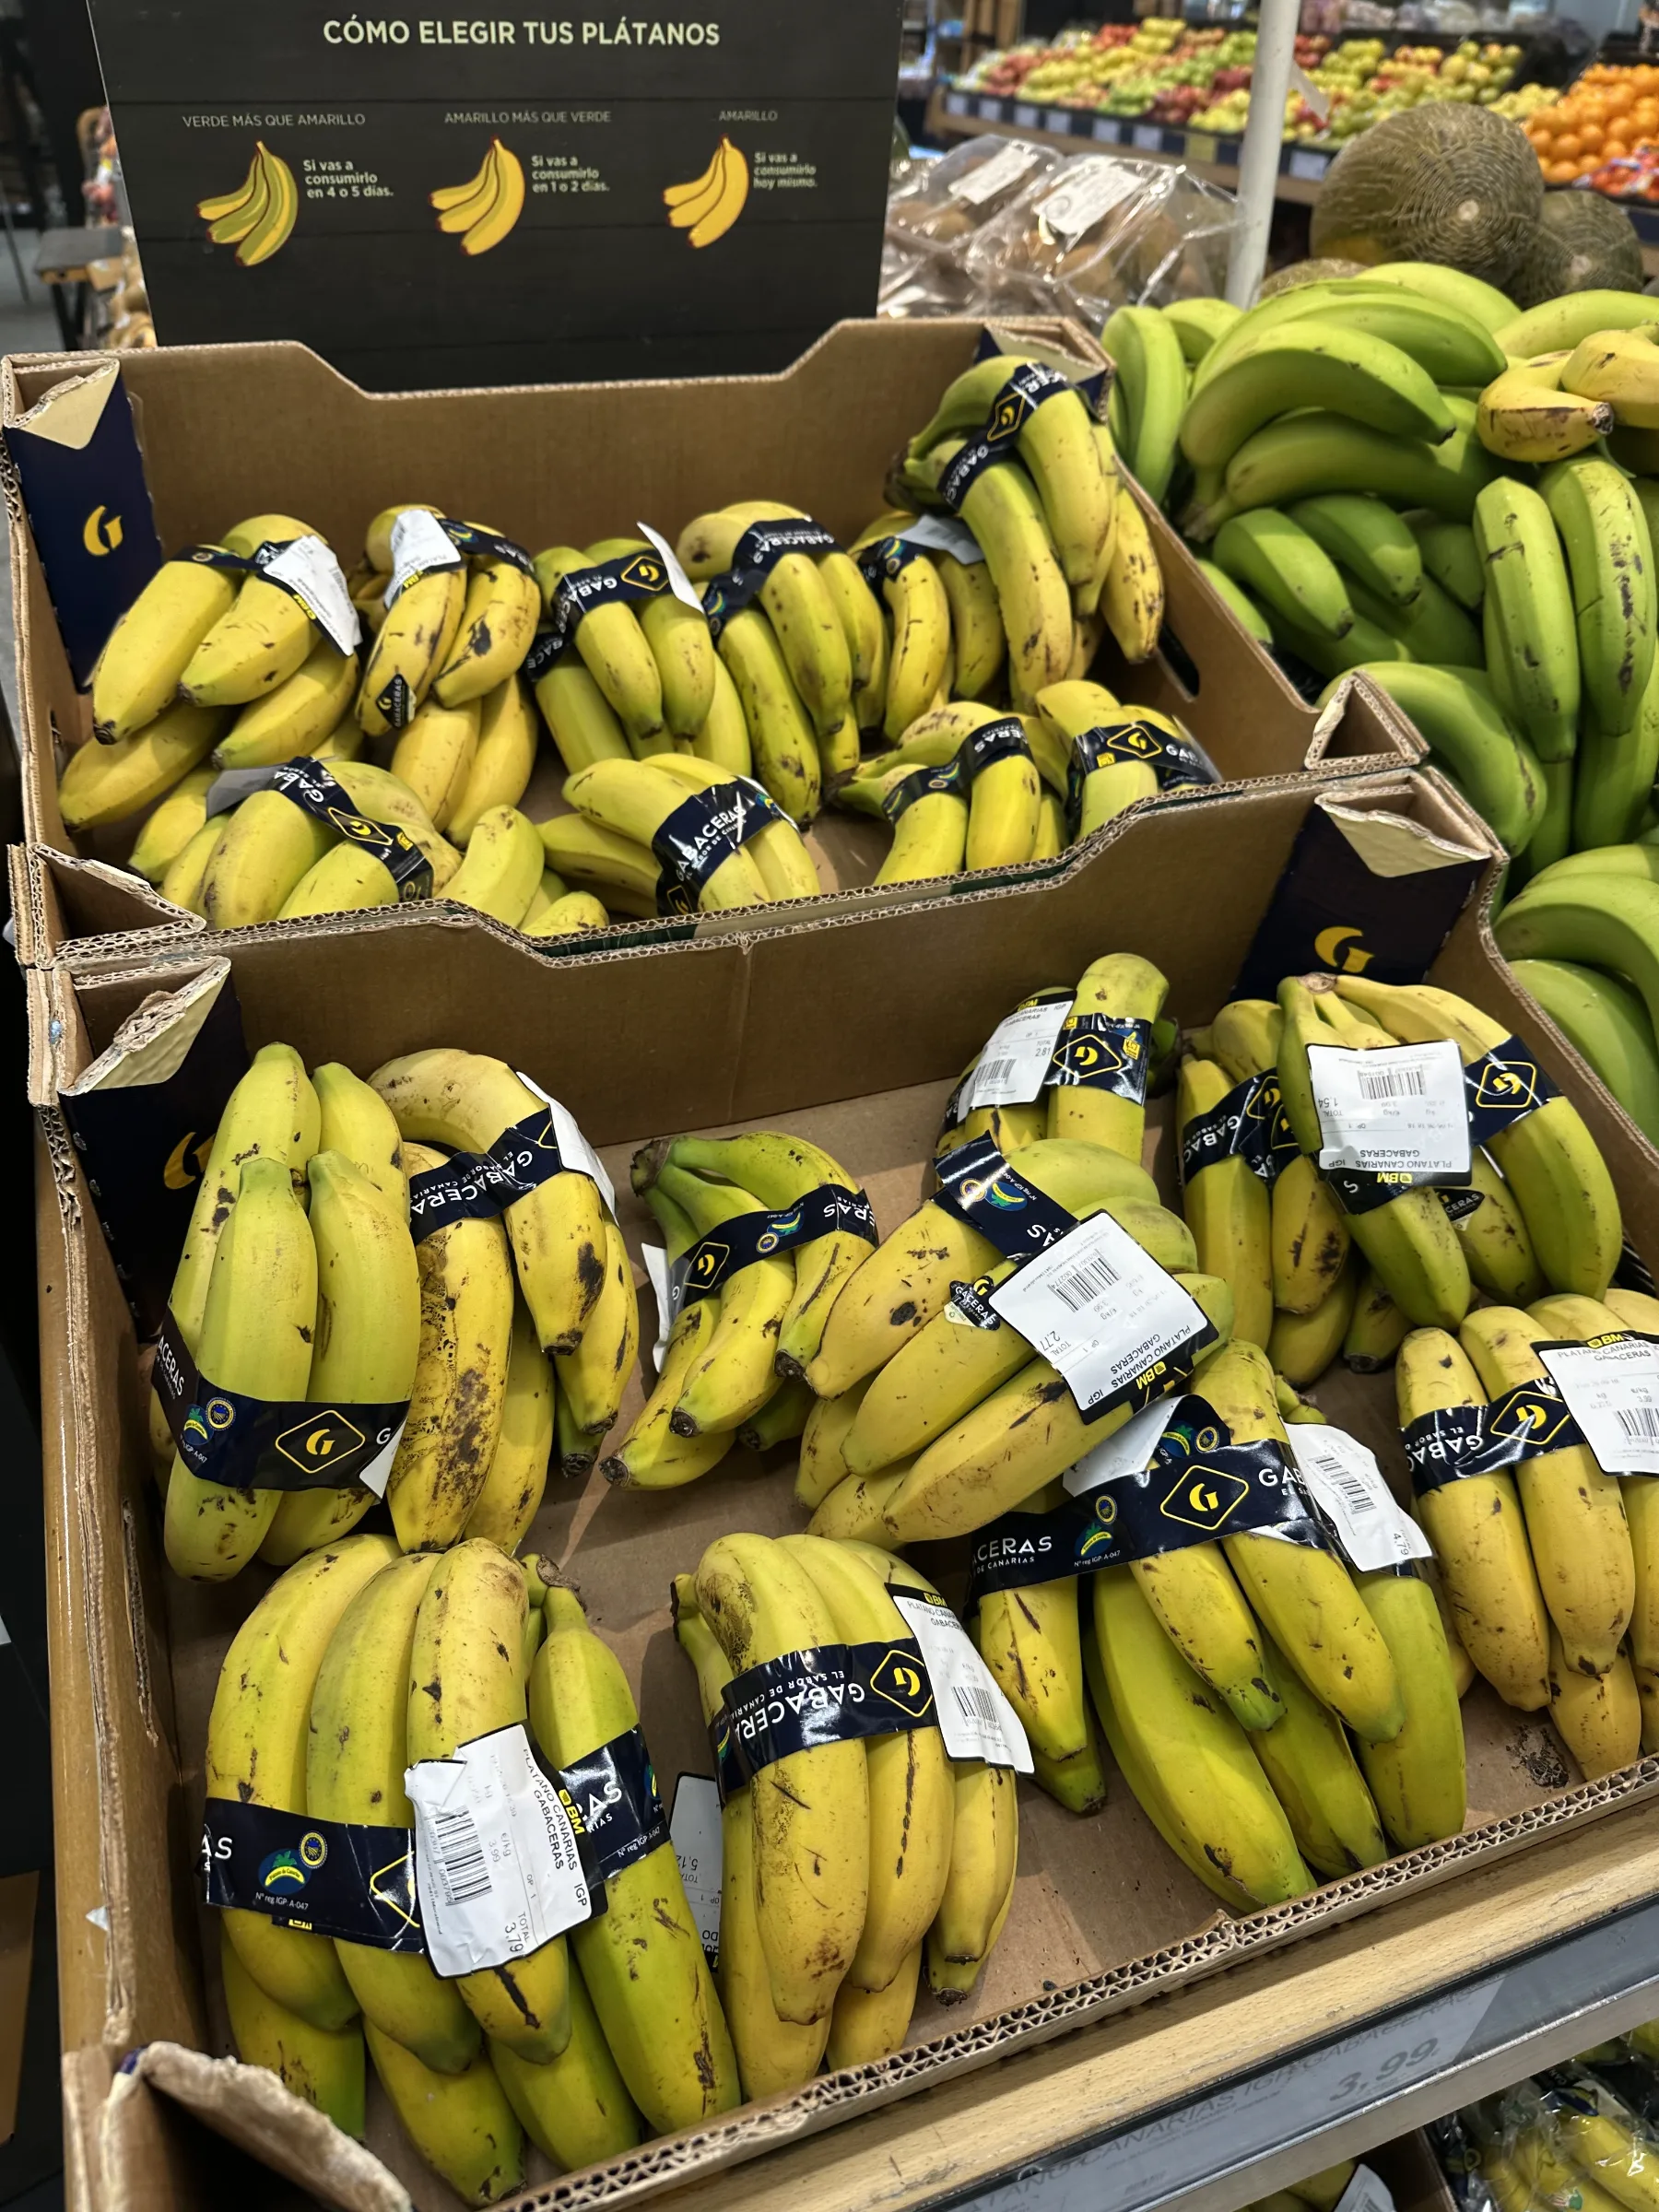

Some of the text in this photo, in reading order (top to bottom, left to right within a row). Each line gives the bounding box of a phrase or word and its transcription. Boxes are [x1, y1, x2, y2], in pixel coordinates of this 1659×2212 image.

[324, 14, 720, 45] CÓMO ELEGIR TUS PLÁTANOS
[182, 112, 366, 127] VERDE MÁS QUE AMARILLO
[444, 110, 612, 124] AMARILLO MÁS QUE VERDE
[719, 111, 778, 121] AMARILLO
[531, 155, 578, 167] Si vas a
[754, 151, 798, 163] Si vas a
[303, 159, 354, 171] Si vas a
[754, 163, 817, 175] consumirlo
[305, 172, 378, 184] consumirlo
[532, 167, 599, 180] consumirlo
[307, 188, 324, 198] en
[326, 187, 336, 197] 4
[340, 188, 348, 197] o
[352, 186, 360, 197] 5
[532, 183, 548, 193] en
[559, 183, 568, 193] o
[571, 182, 579, 192] 2
[676, 805, 747, 882] GABACERAS
[1323, 1109, 1343, 1117] TOTAL
[1359, 1149, 1420, 1158] GABACERAS
[1328, 1159, 1453, 1169] PLATANO CANARIAS IGP
[1053, 1340, 1073, 1357] TOTAL
[1110, 1334, 1161, 1375] GABACERAS
[1600, 1341, 1650, 1355] CANARIAS
[1088, 1324, 1192, 1405] PLATANO CANARIAS IGP
[376, 1428, 392, 1445] G
[1103, 1550, 1122, 1560] A-047
[987, 1556, 1035, 1570] CANARIAS
[830, 1670, 844, 1679] EL
[770, 1687, 783, 1698] DE
[564, 1806, 585, 1835] BM
[523, 1748, 588, 1907] PLATANO CANARIAS IGP
[534, 1790, 564, 1870] GABACERAS
[288, 1899, 309, 1911] A-047
[518, 1911, 530, 1943] TOTAL
[504, 1922, 524, 1953] 3,79
